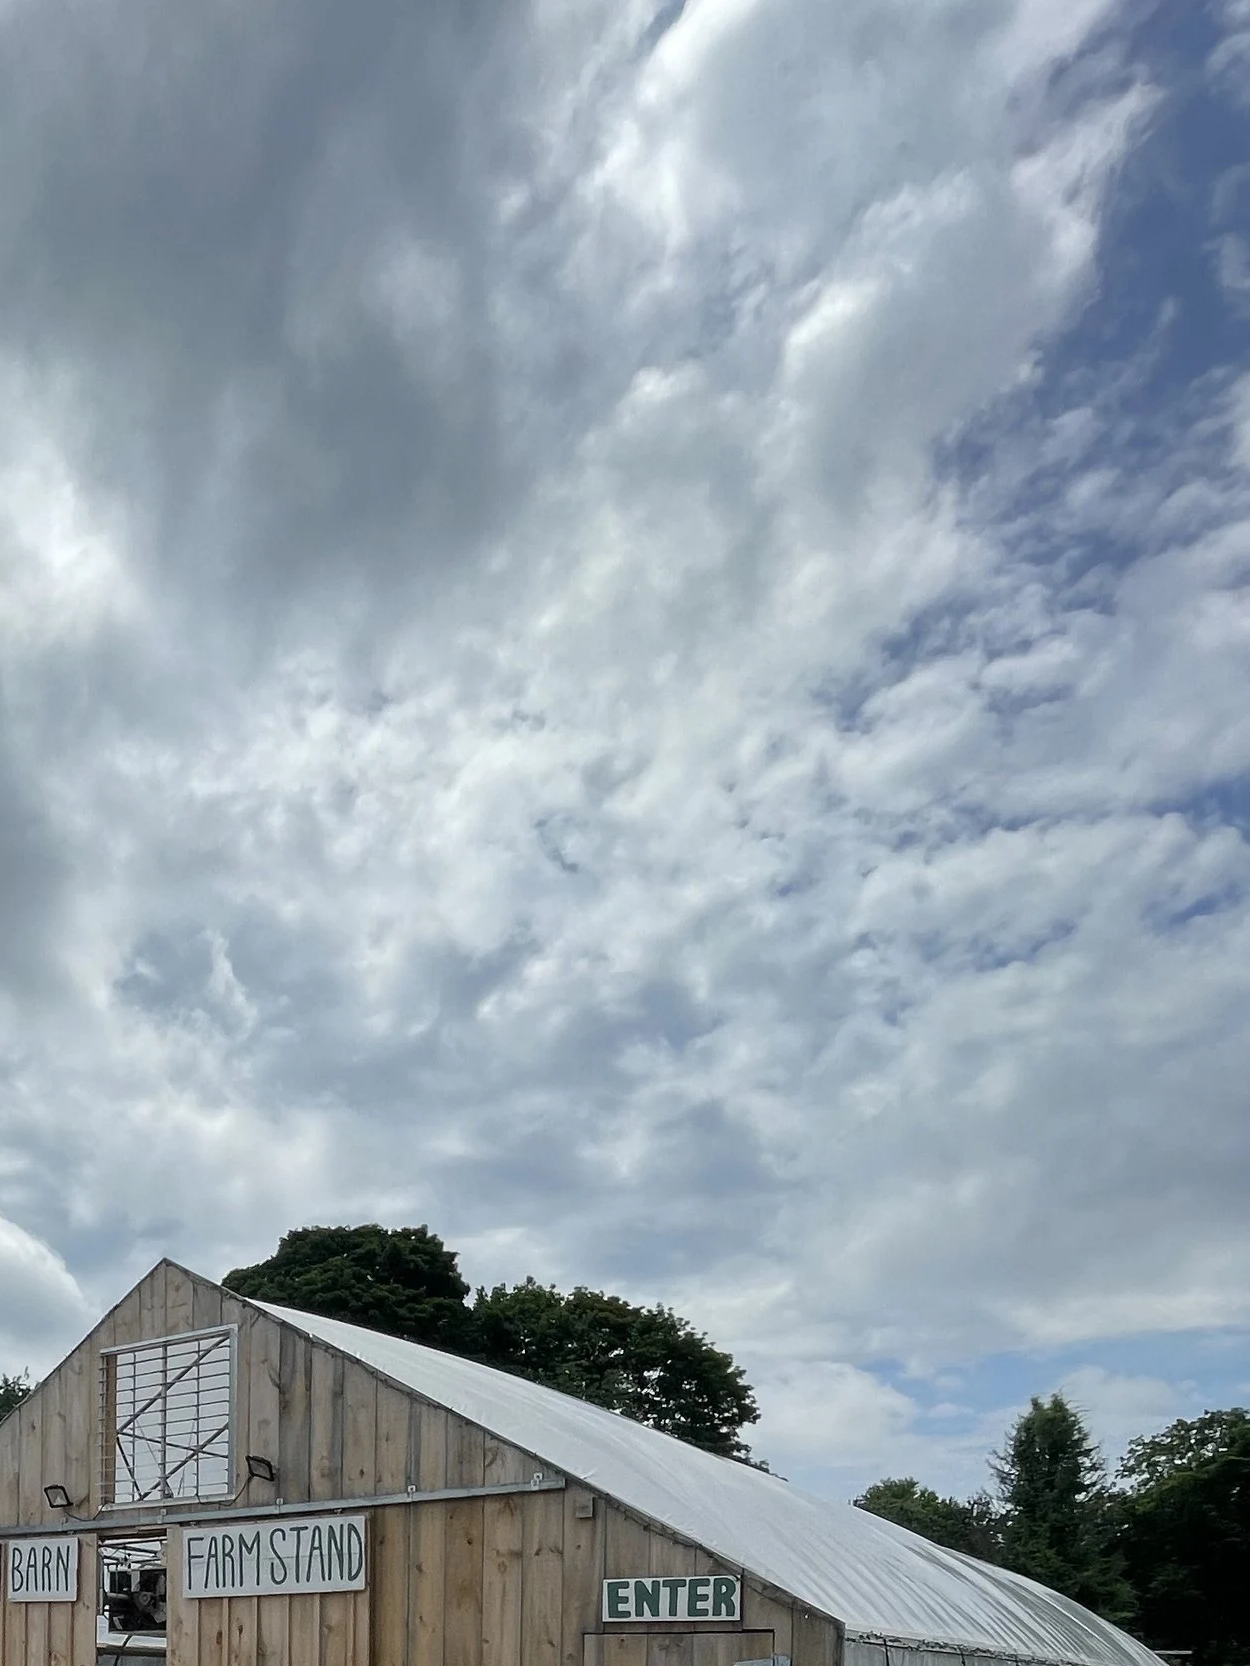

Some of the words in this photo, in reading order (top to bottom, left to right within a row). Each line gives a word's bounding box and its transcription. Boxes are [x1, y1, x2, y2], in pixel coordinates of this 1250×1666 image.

[11, 1546, 70, 1592] BARN
[188, 1530, 260, 1590] FARM
[269, 1523, 363, 1586] STAND
[607, 1577, 736, 1618] ENTER
